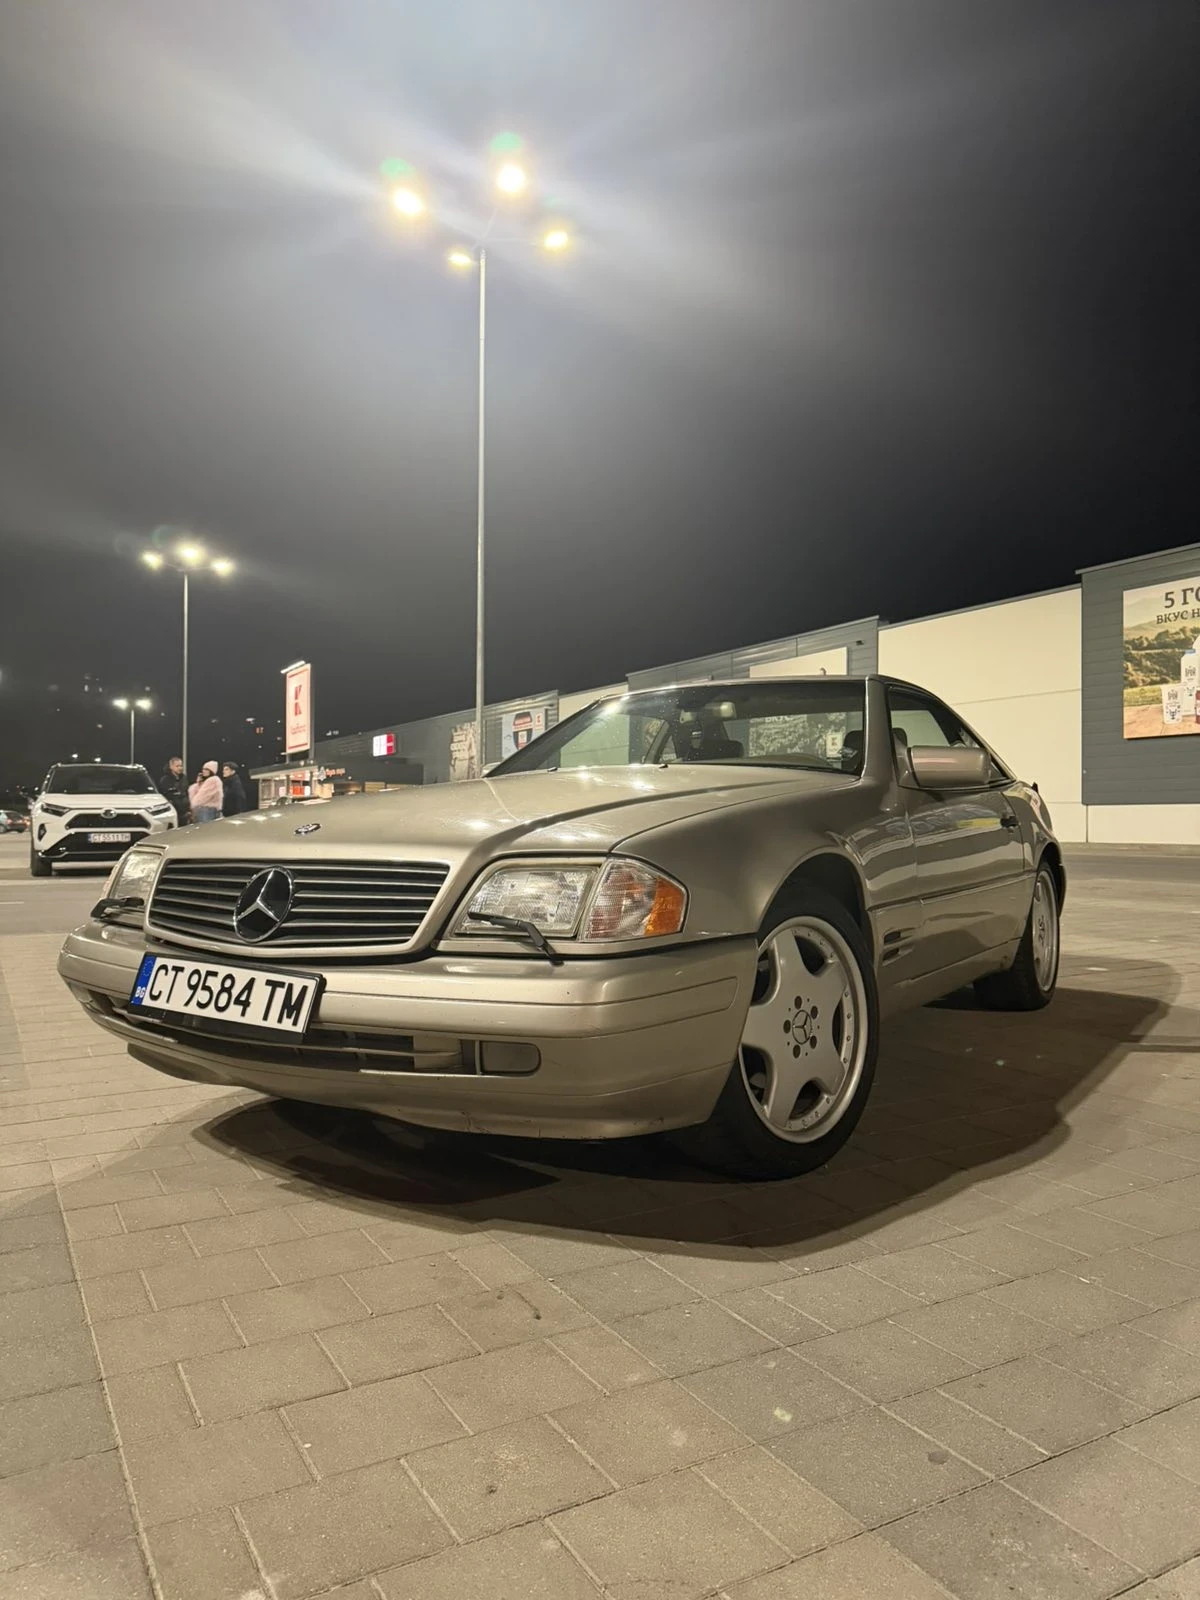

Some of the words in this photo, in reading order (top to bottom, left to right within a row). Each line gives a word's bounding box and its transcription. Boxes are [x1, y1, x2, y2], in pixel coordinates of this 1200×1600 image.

[1164, 591, 1175, 608] 5
[1156, 610, 1188, 624] ВКУС
[294, 684, 302, 716] K
[134, 986, 146, 998] BG
[148, 964, 185, 1004] CT
[183, 968, 256, 1017] 9584
[262, 979, 309, 1027] TM
